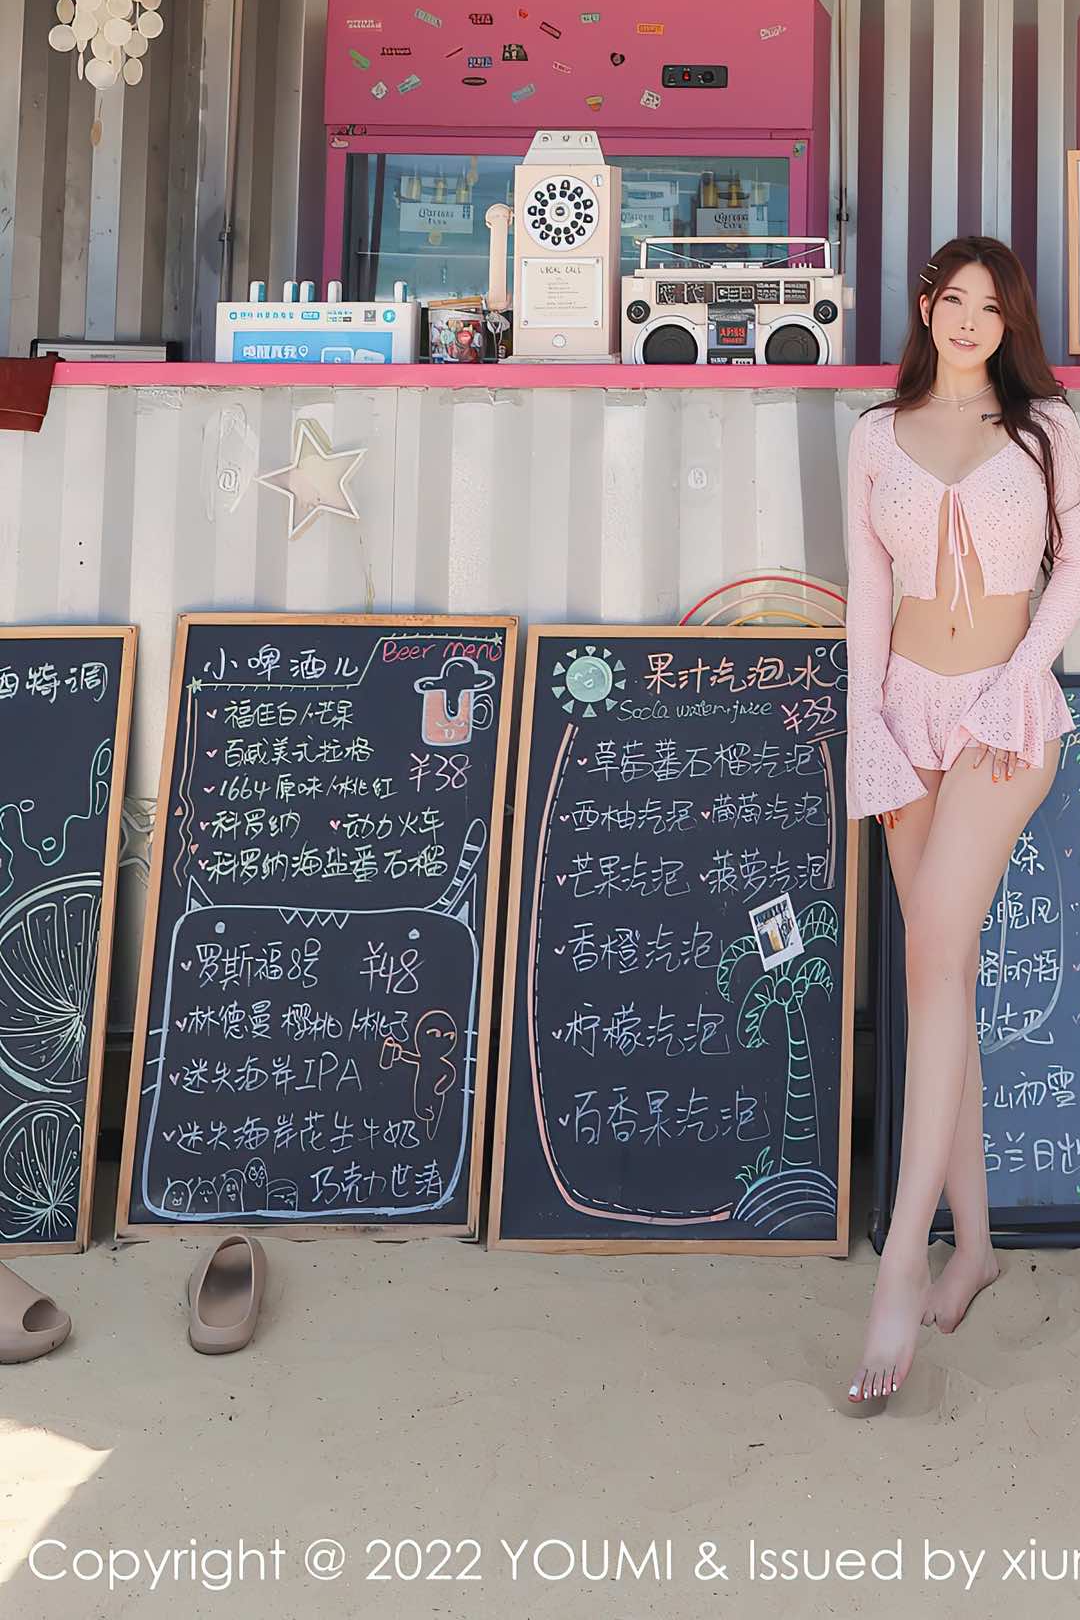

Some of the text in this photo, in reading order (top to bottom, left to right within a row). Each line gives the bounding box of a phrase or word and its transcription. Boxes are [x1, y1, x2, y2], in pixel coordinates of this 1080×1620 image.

[203, 644, 359, 681] 小啤酒儿
[382, 641, 502, 663] Beer menu
[211, 807, 301, 840] 科罗纳
[343, 807, 444, 844] 动力火车
[177, 1111, 420, 1155] 迷失海岸花生牛奶
